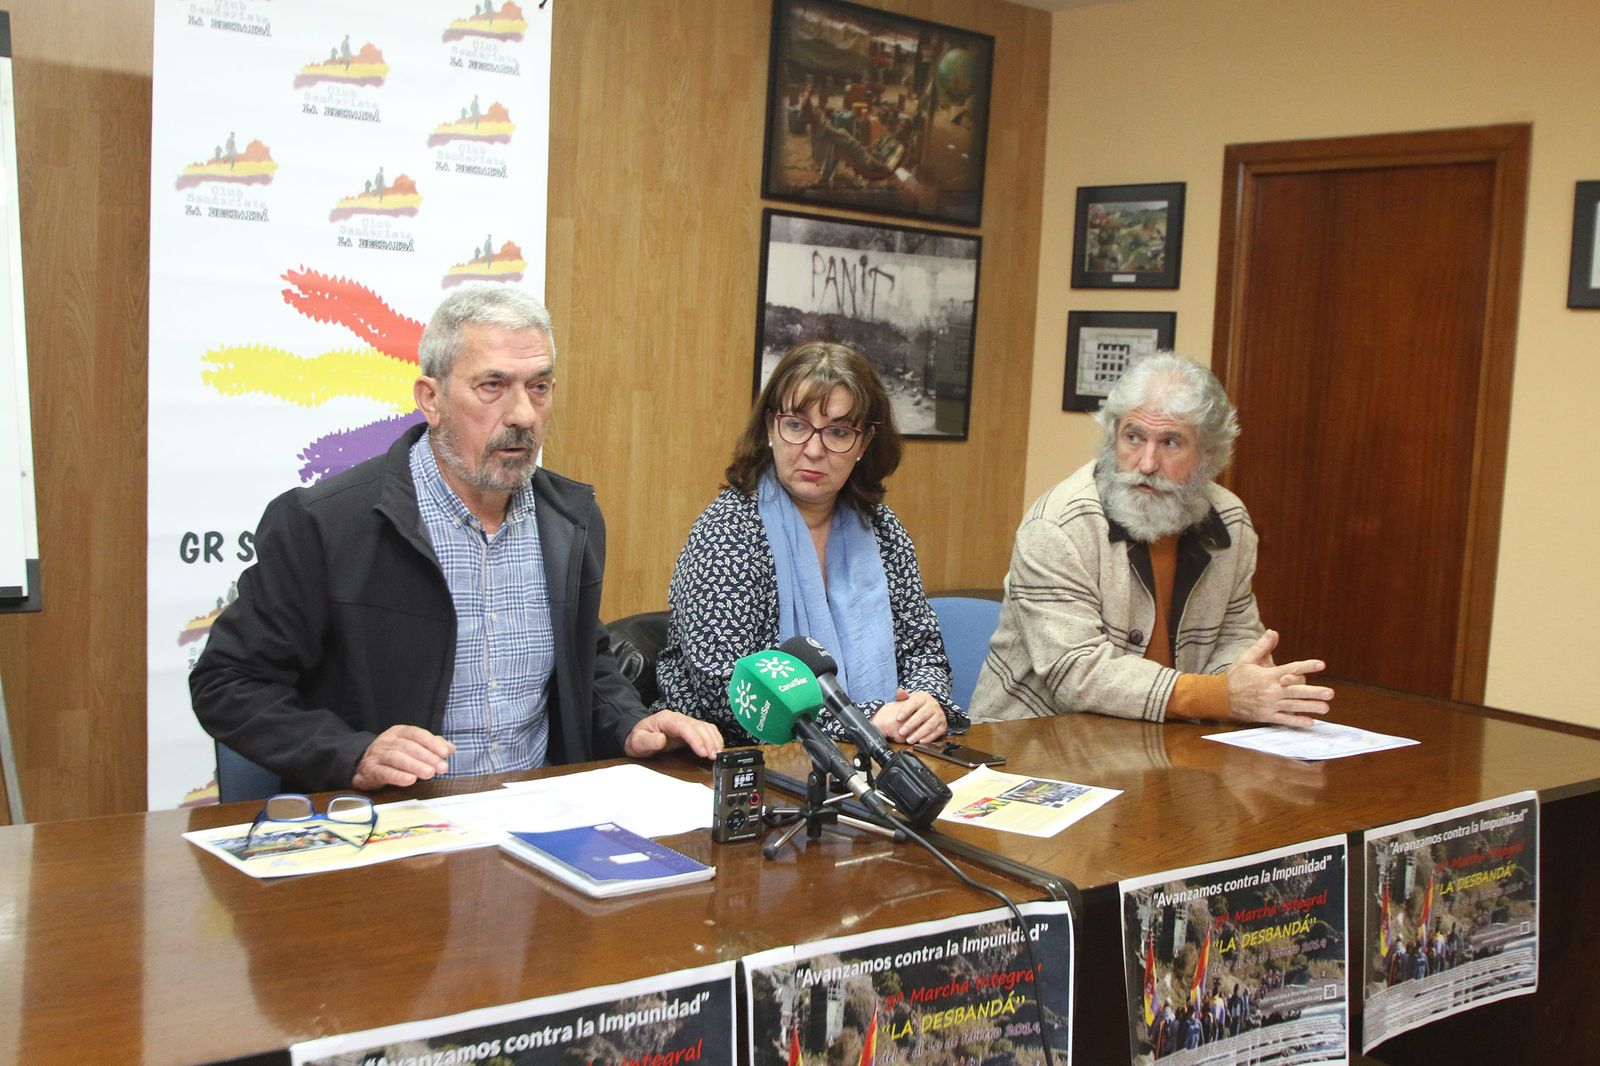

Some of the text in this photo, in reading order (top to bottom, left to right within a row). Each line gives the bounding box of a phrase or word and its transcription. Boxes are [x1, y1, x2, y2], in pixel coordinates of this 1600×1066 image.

[179, 530, 256, 564] GR S
[778, 676, 808, 692] CanalSur
[756, 700, 772, 732] CanalSur
[1442, 825, 1470, 841] contra
[1471, 821, 1479, 833] la
[1153, 855, 1332, 908] “Avanzamos contra la Impunidad”
[1233, 902, 1277, 928] Marcha
[1213, 913, 1317, 954] “LA DESBANDÁ”
[795, 955, 893, 989] “Avanzamos
[894, 944, 945, 968] contra
[946, 941, 960, 958] la
[909, 978, 969, 1006] Marcha
[503, 1025, 573, 1055] contra
[576, 1017, 595, 1039] la
[599, 990, 710, 1035] Impunidad”
[881, 990, 1026, 1041] “LA DESBANDÁ”
